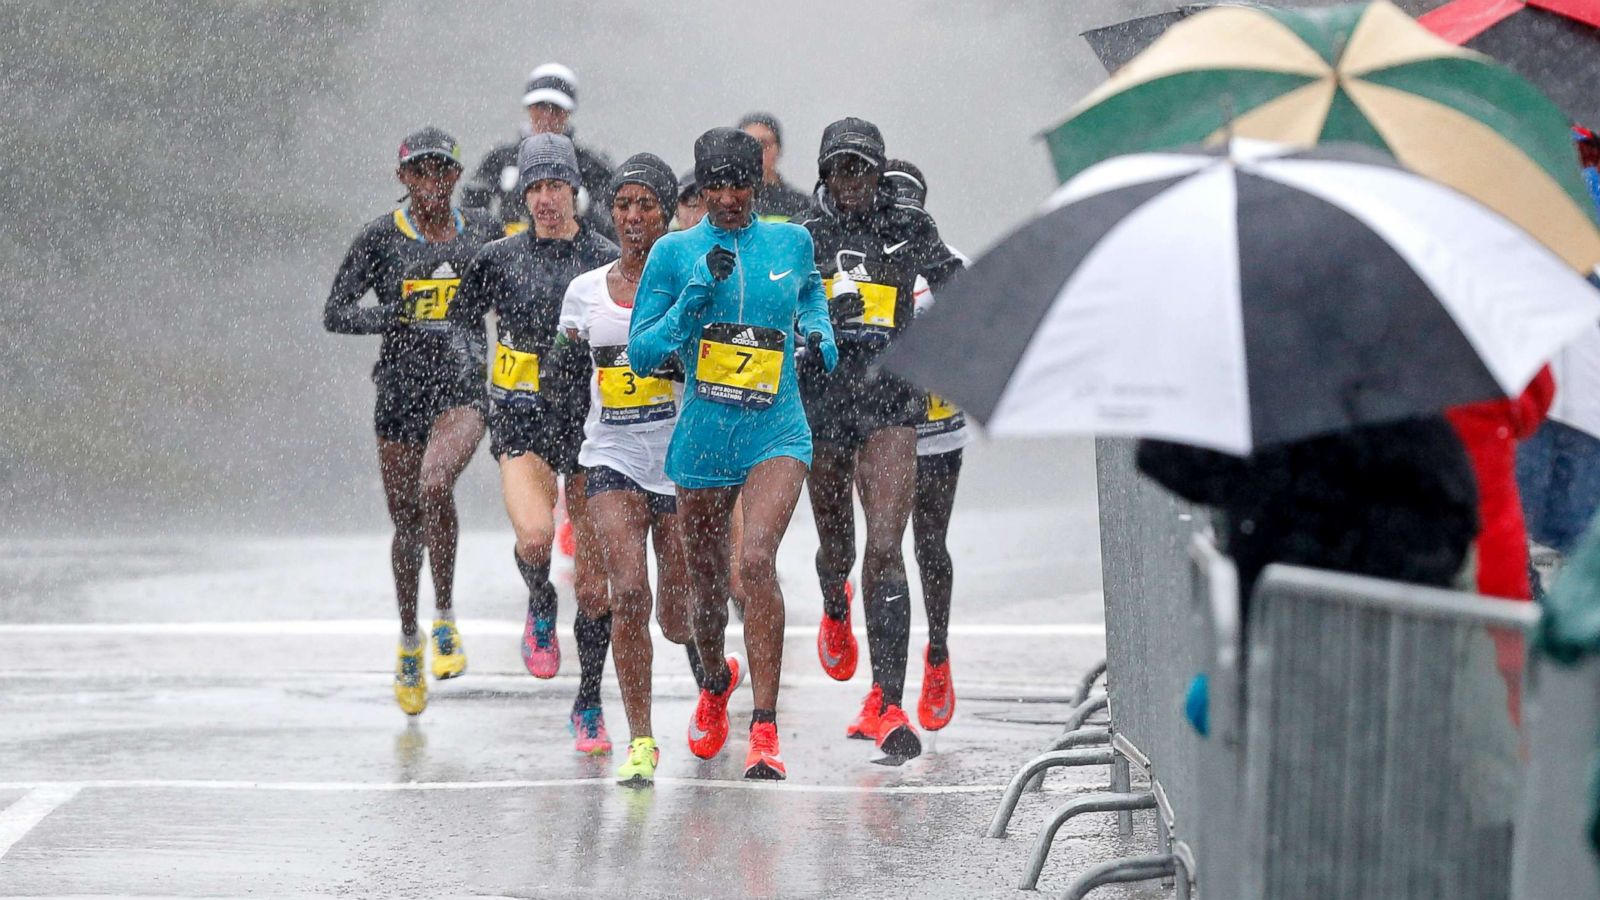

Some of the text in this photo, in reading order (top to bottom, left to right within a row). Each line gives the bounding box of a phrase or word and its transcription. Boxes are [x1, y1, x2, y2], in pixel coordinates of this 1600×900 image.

[702, 343, 712, 359] F
[731, 337, 759, 347] adidas
[500, 353, 516, 376] 17
[735, 351, 753, 375] 7
[622, 372, 637, 395] 3
